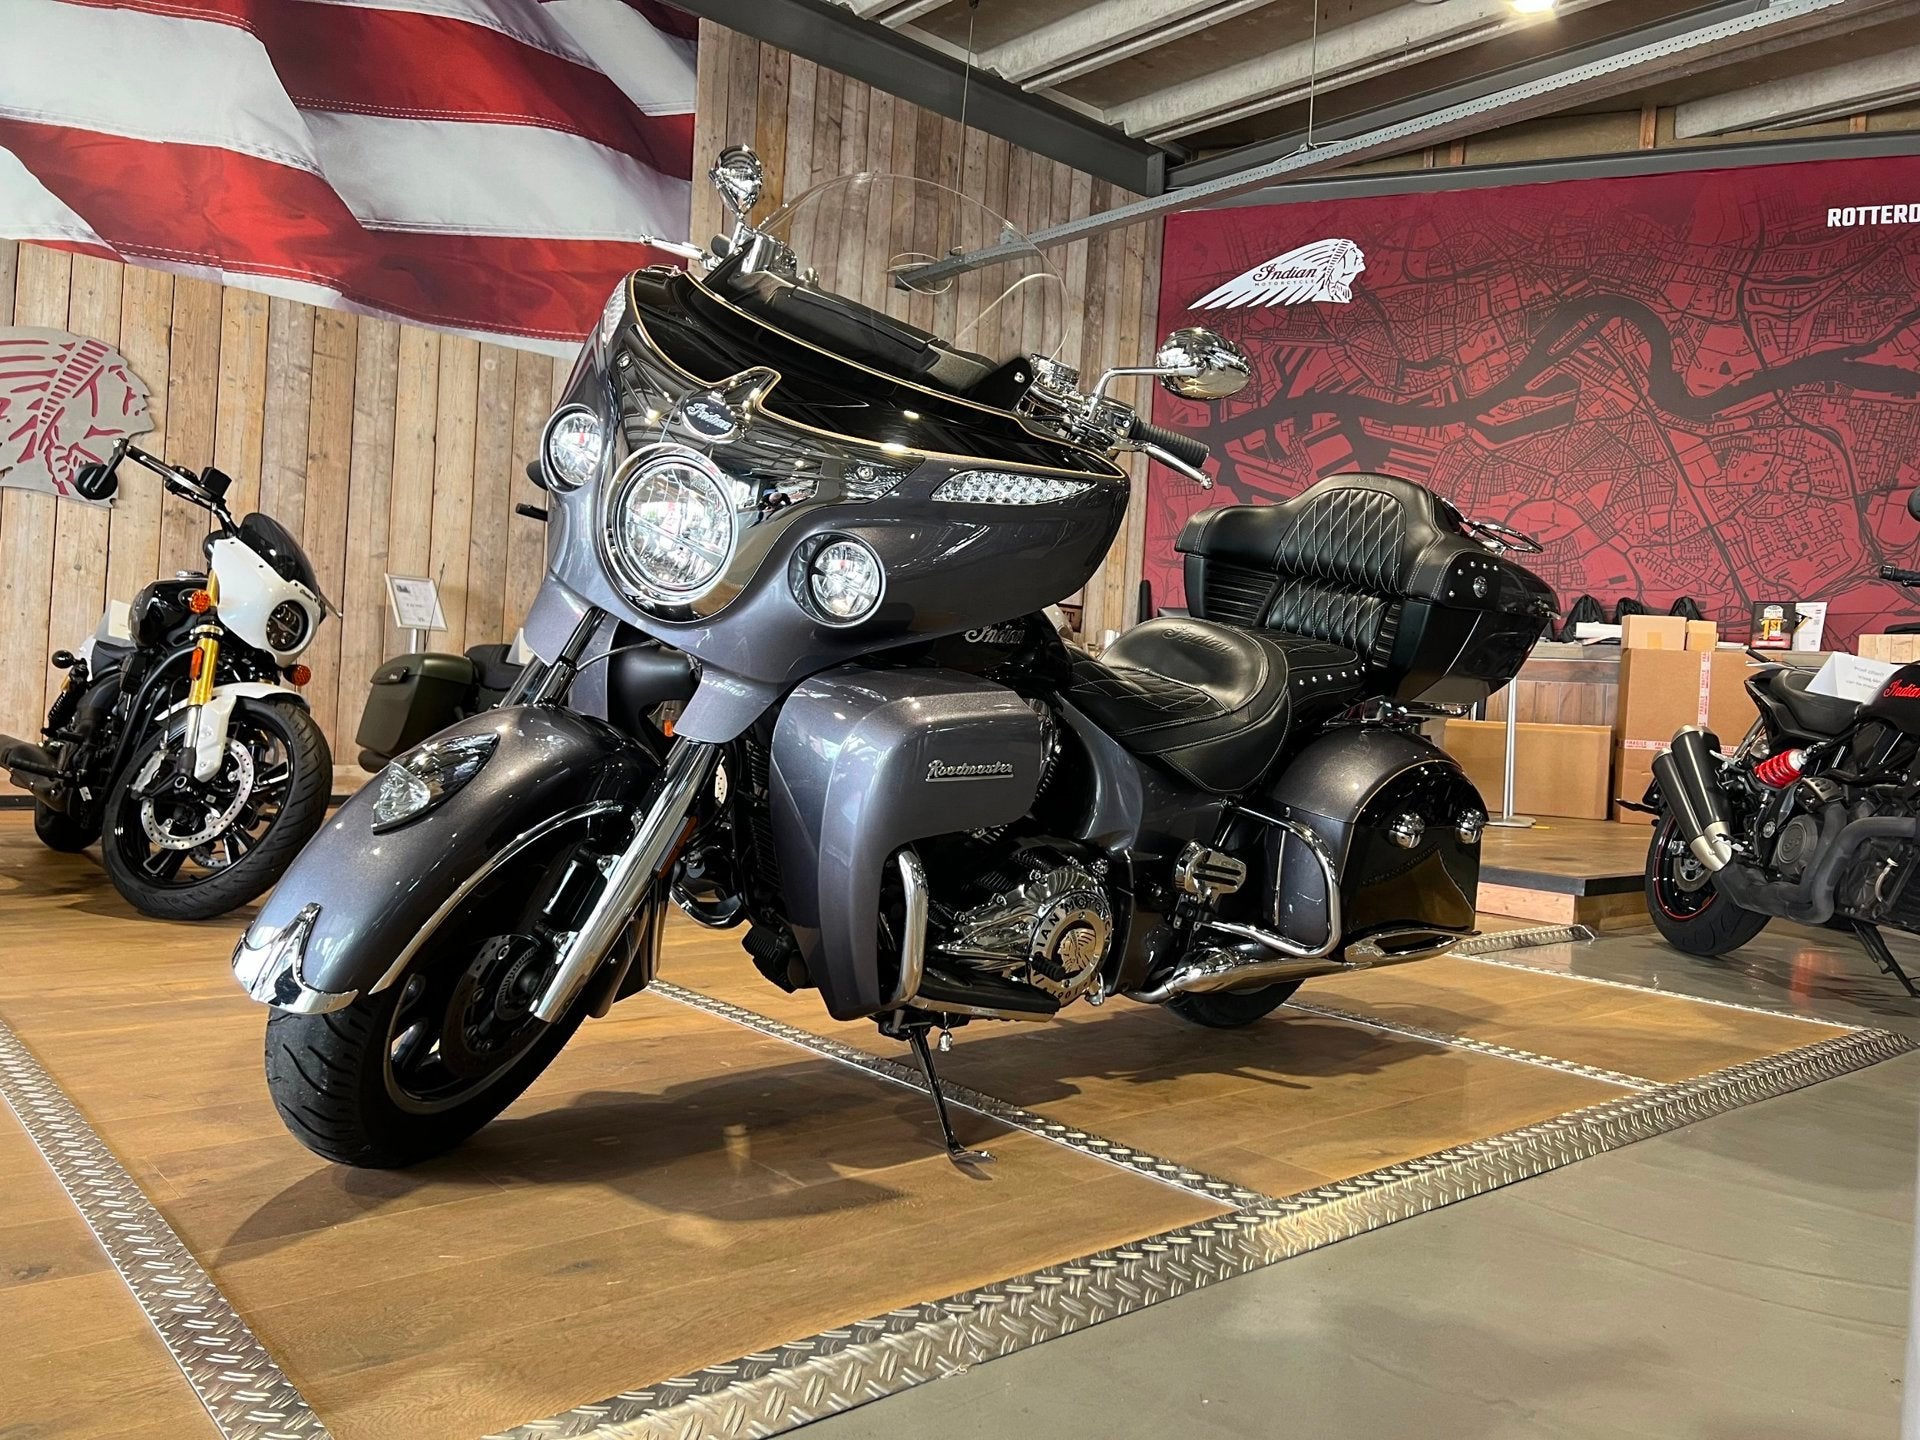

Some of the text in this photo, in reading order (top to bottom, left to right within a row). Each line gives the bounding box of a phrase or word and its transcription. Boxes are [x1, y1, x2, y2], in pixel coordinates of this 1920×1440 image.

[1827, 203, 1920, 227] ROTTERD
[1253, 263, 1318, 282] Indian
[1254, 279, 1315, 287] MOTORCYCLE
[686, 402, 732, 431] Indian
[965, 624, 1025, 644] Indian
[1161, 625, 1234, 654] Indian
[927, 760, 1013, 779] Roadmaster
